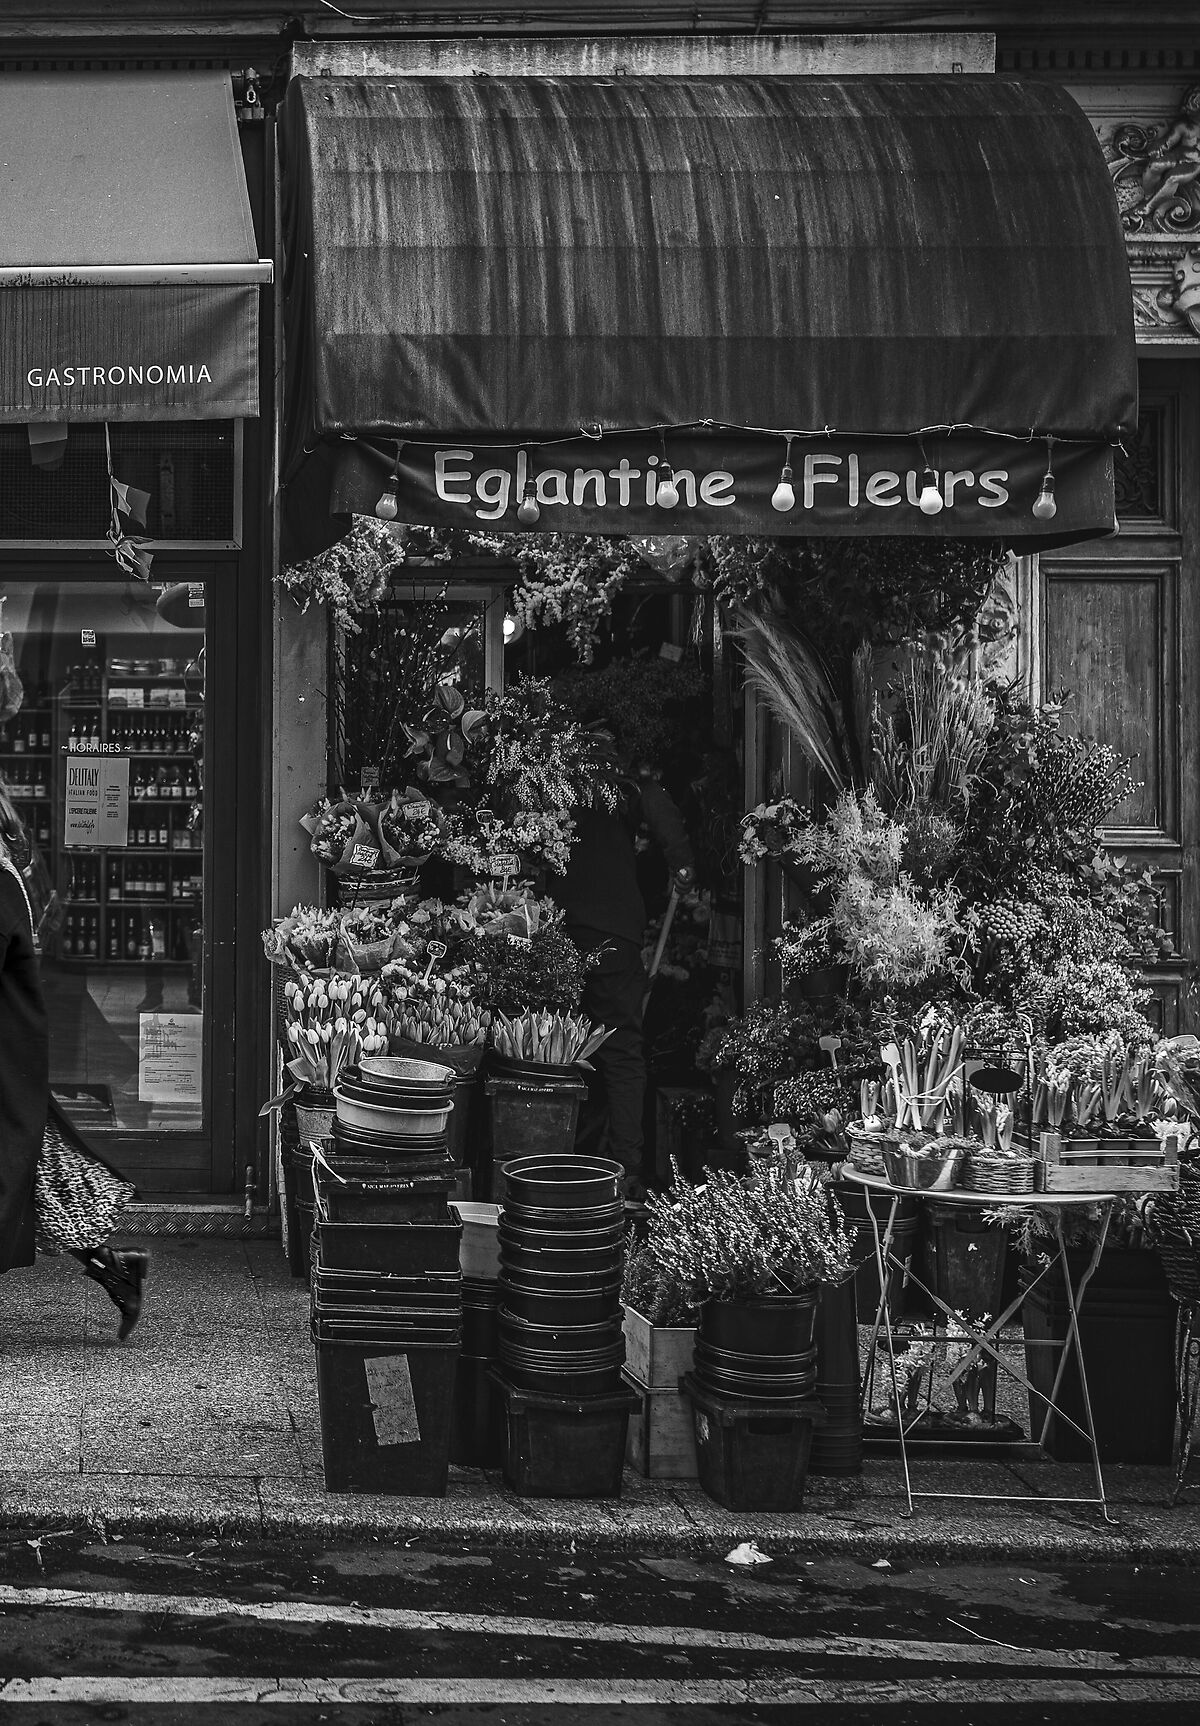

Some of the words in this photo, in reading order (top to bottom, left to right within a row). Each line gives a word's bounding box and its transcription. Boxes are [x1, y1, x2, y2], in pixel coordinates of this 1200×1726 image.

[27, 364, 222, 387] GASTRONOMIA
[434, 450, 736, 520] Eglantine
[803, 453, 1009, 508] Fleurs
[69, 743, 121, 753] HORAIRES
[69, 767, 99, 786] DELITALY
